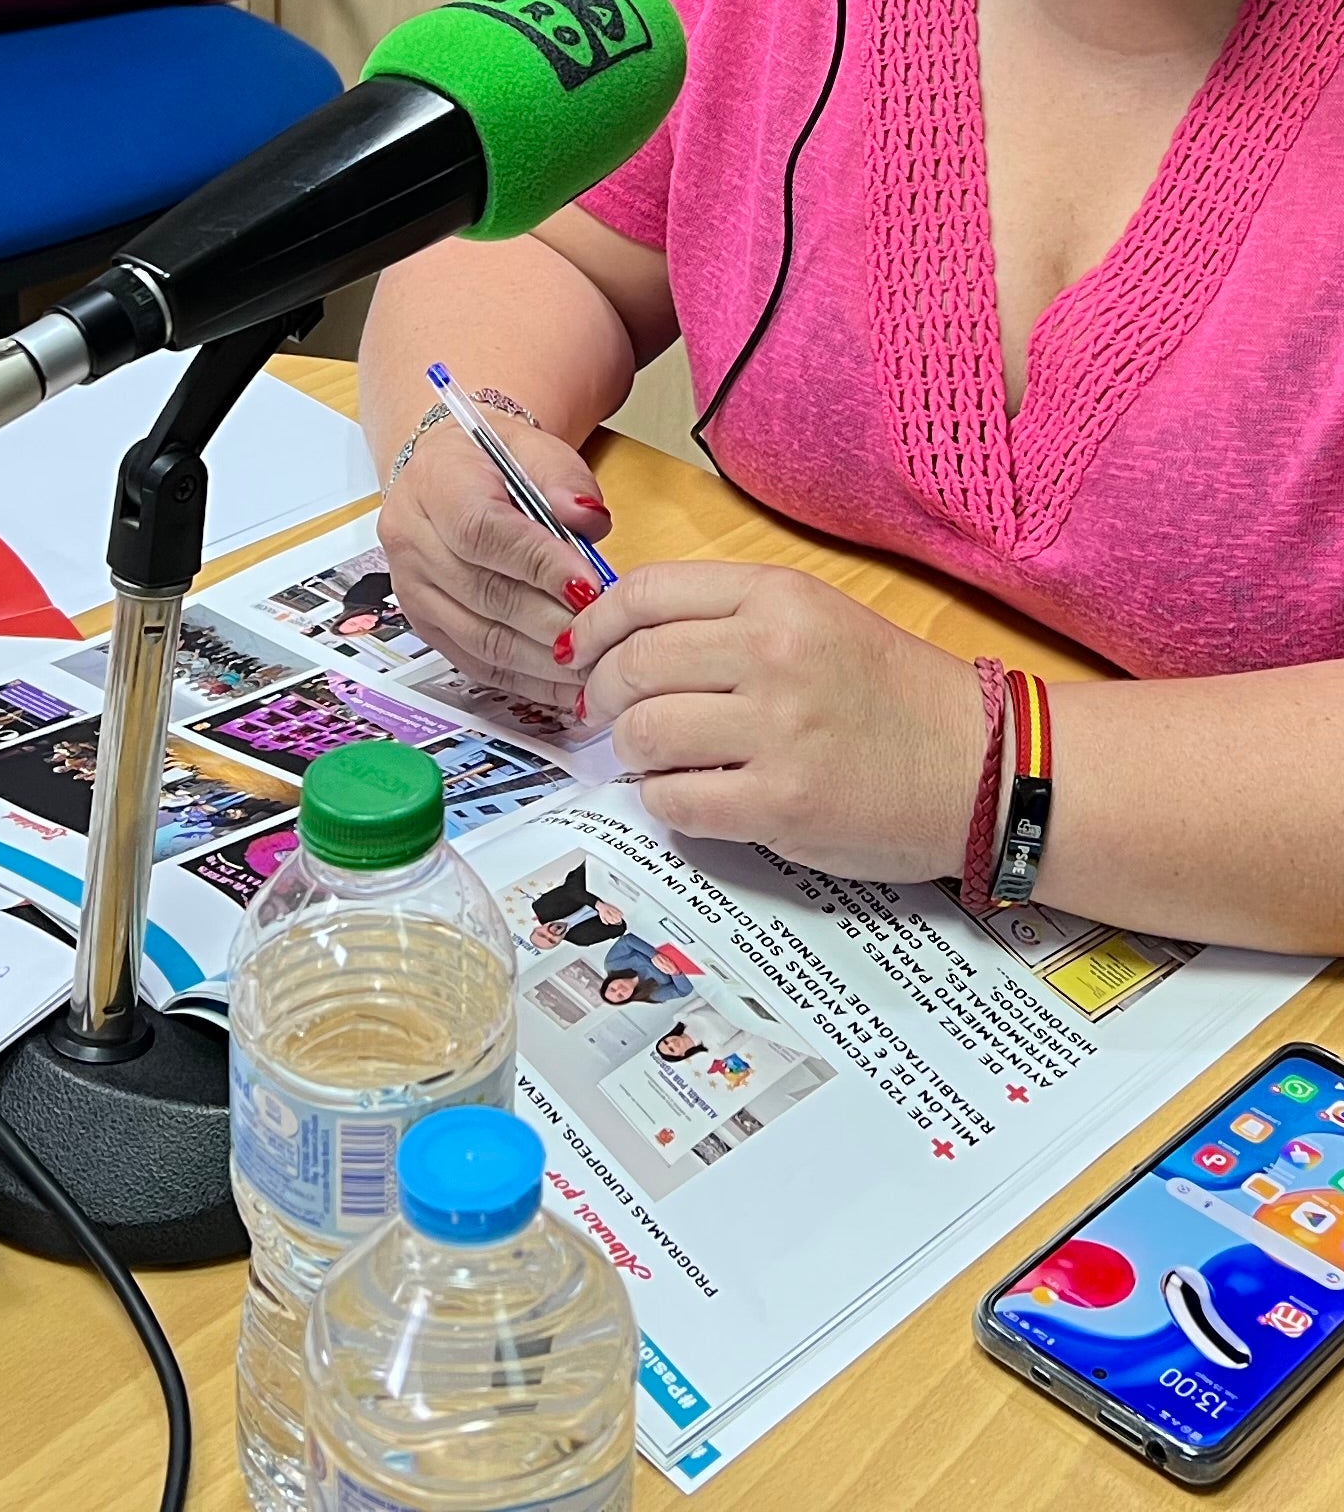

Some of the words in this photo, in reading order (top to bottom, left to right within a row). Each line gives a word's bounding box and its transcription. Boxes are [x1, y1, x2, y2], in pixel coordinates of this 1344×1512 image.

[570, 809, 633, 833] MAYORÍA
[574, 823, 597, 833] DE
[597, 833, 663, 874] IMPORTE
[634, 835, 658, 849] SU
[660, 851, 688, 869] EN
[747, 838, 797, 879] AYUD
[1012, 845, 1030, 875] PSOE
[662, 875, 686, 894] UN
[796, 879, 821, 900] DE
[800, 860, 890, 943] PROGRAMA
[687, 896, 721, 923] CON
[690, 866, 783, 956] SOLICITADAS,
[820, 900, 837, 916] €
[837, 914, 861, 938] DE
[770, 916, 846, 995] VIVIENDAS.
[892, 944, 933, 983] PARA
[908, 910, 977, 977] MEJORAS
[731, 929, 814, 1008] ATENDIDOS,
[786, 961, 847, 1015] AYUDAS
[863, 943, 938, 1013] MILLONES
[845, 994, 870, 1015] DE
[946, 968, 1067, 1078] PATRIMONIALES,
[997, 968, 1097, 1055] HISTÓRICOS...
[813, 1014, 877, 1077] VECINOS
[848, 1022, 872, 1043] EN
[935, 988, 1053, 1087] AYUNTAMIENTO
[939, 1016, 977, 1050] DIEZ
[991, 986, 1080, 1067] TURÍSTICOS,
[872, 1044, 889, 1061] €
[979, 1053, 1004, 1074] DE
[869, 1016, 995, 1134] REHABILITACIÓN
[880, 1080, 907, 1105] 120
[890, 1064, 915, 1085] DE
[518, 1076, 562, 1124] NUEVA
[907, 1107, 932, 1129] DE
[918, 1090, 979, 1146] MILLÓN
[545, 1172, 585, 1199] por
[574, 1204, 651, 1279] Albuñol
[631, 1206, 718, 1297] PROGRAMAS
[1160, 1367, 1227, 1418] 13:00
